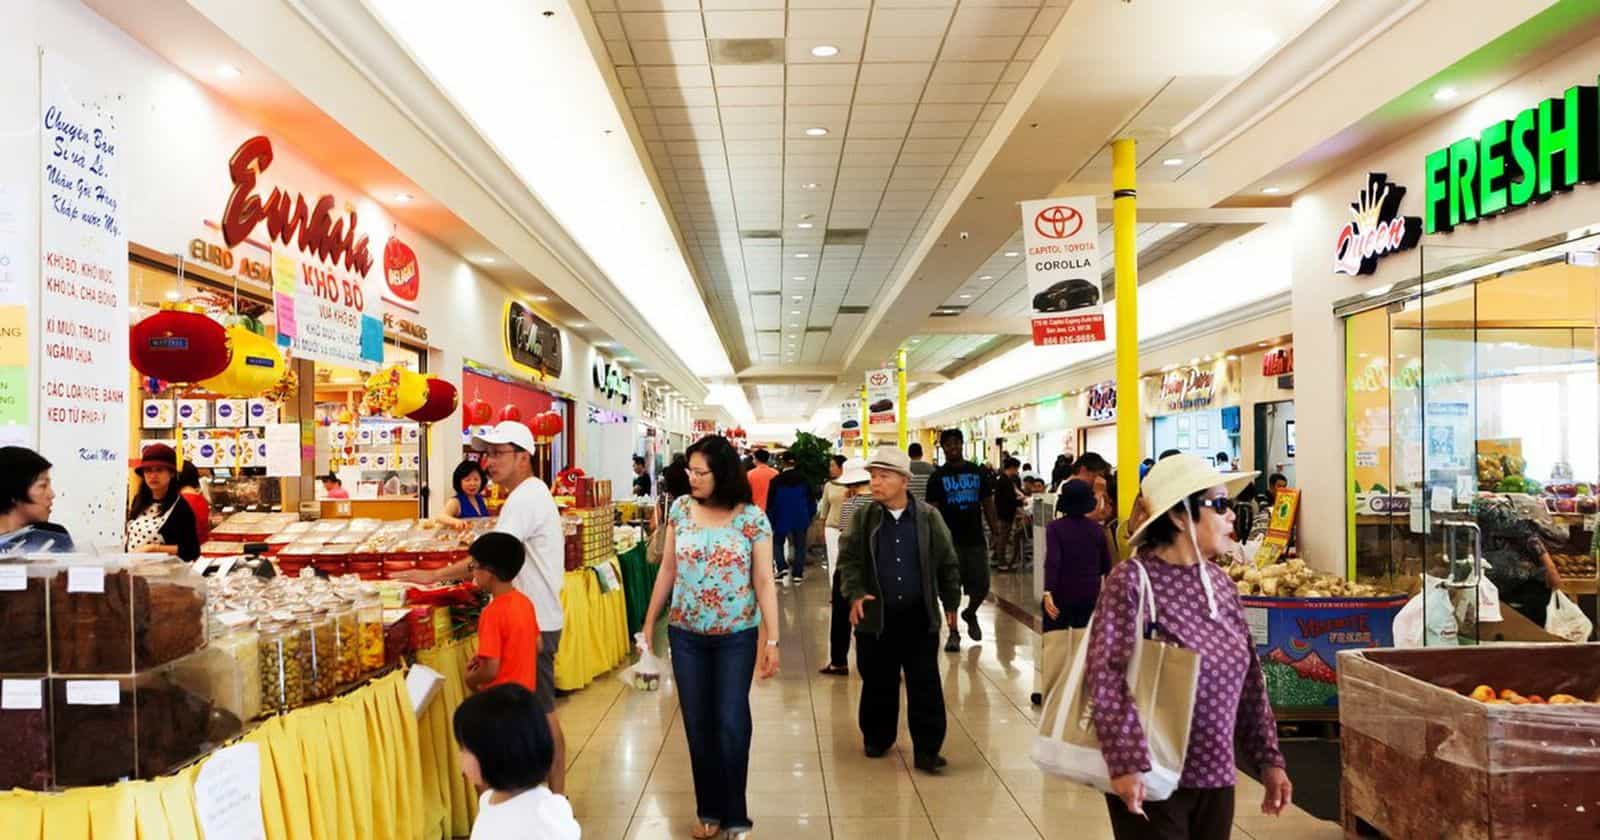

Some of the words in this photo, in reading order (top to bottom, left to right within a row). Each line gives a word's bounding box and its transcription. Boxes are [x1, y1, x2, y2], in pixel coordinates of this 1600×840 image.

[1425, 85, 1580, 235] FRESH
[222, 135, 373, 279] Eurasia
[191, 238, 233, 270] EURO
[1028, 245, 1062, 256] CAPITOL
[1065, 242, 1095, 253] TOYOTA
[1035, 258, 1092, 272] COROLLA
[1336, 216, 1406, 275] Queen
